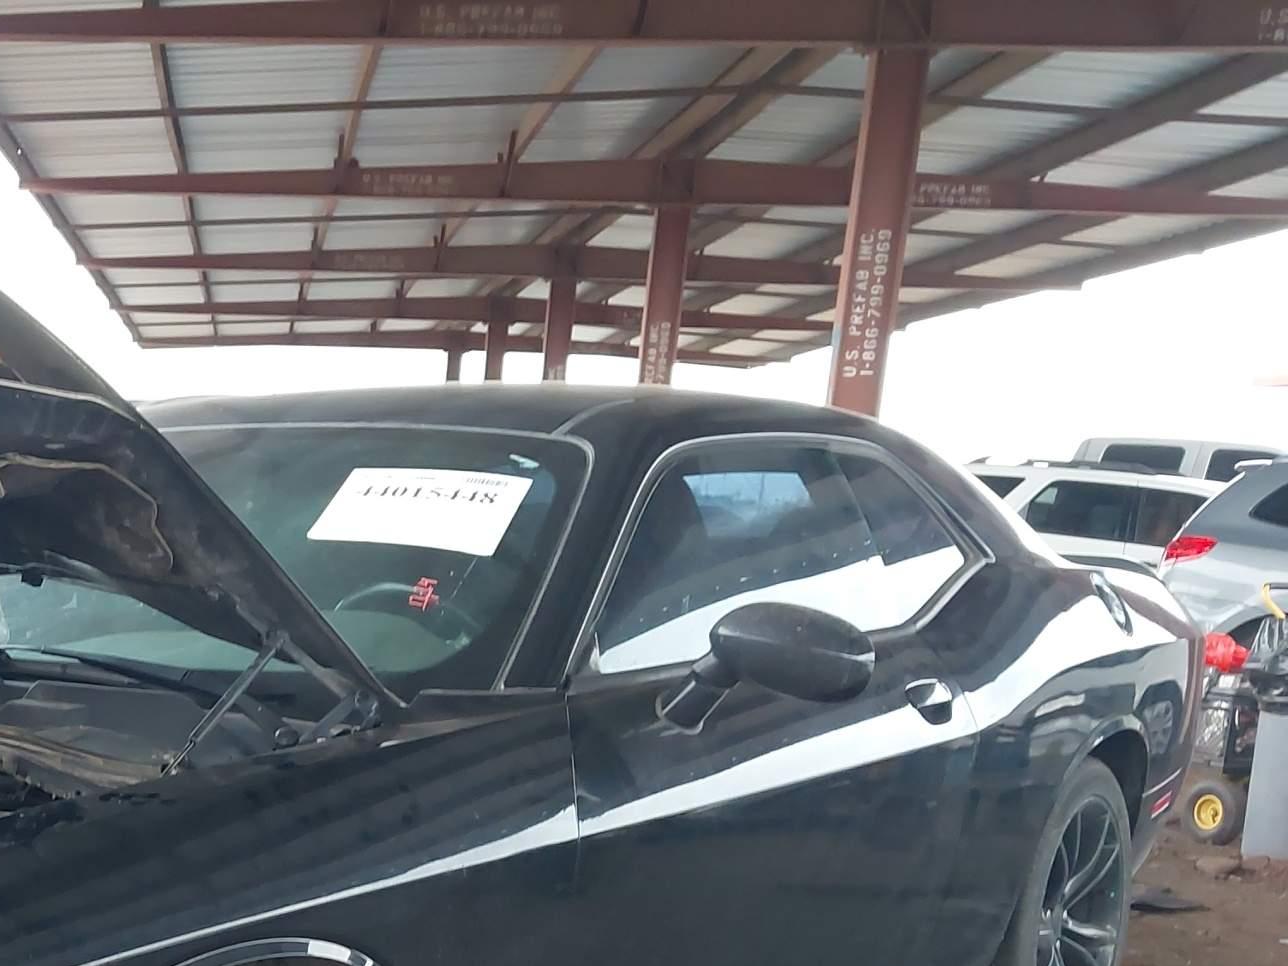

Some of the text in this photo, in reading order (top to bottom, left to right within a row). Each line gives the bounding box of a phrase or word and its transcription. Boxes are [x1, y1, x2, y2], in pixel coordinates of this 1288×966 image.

[842, 228, 876, 378] U.S. PREFAB INC.
[859, 228, 893, 376] 1-866-799-0969
